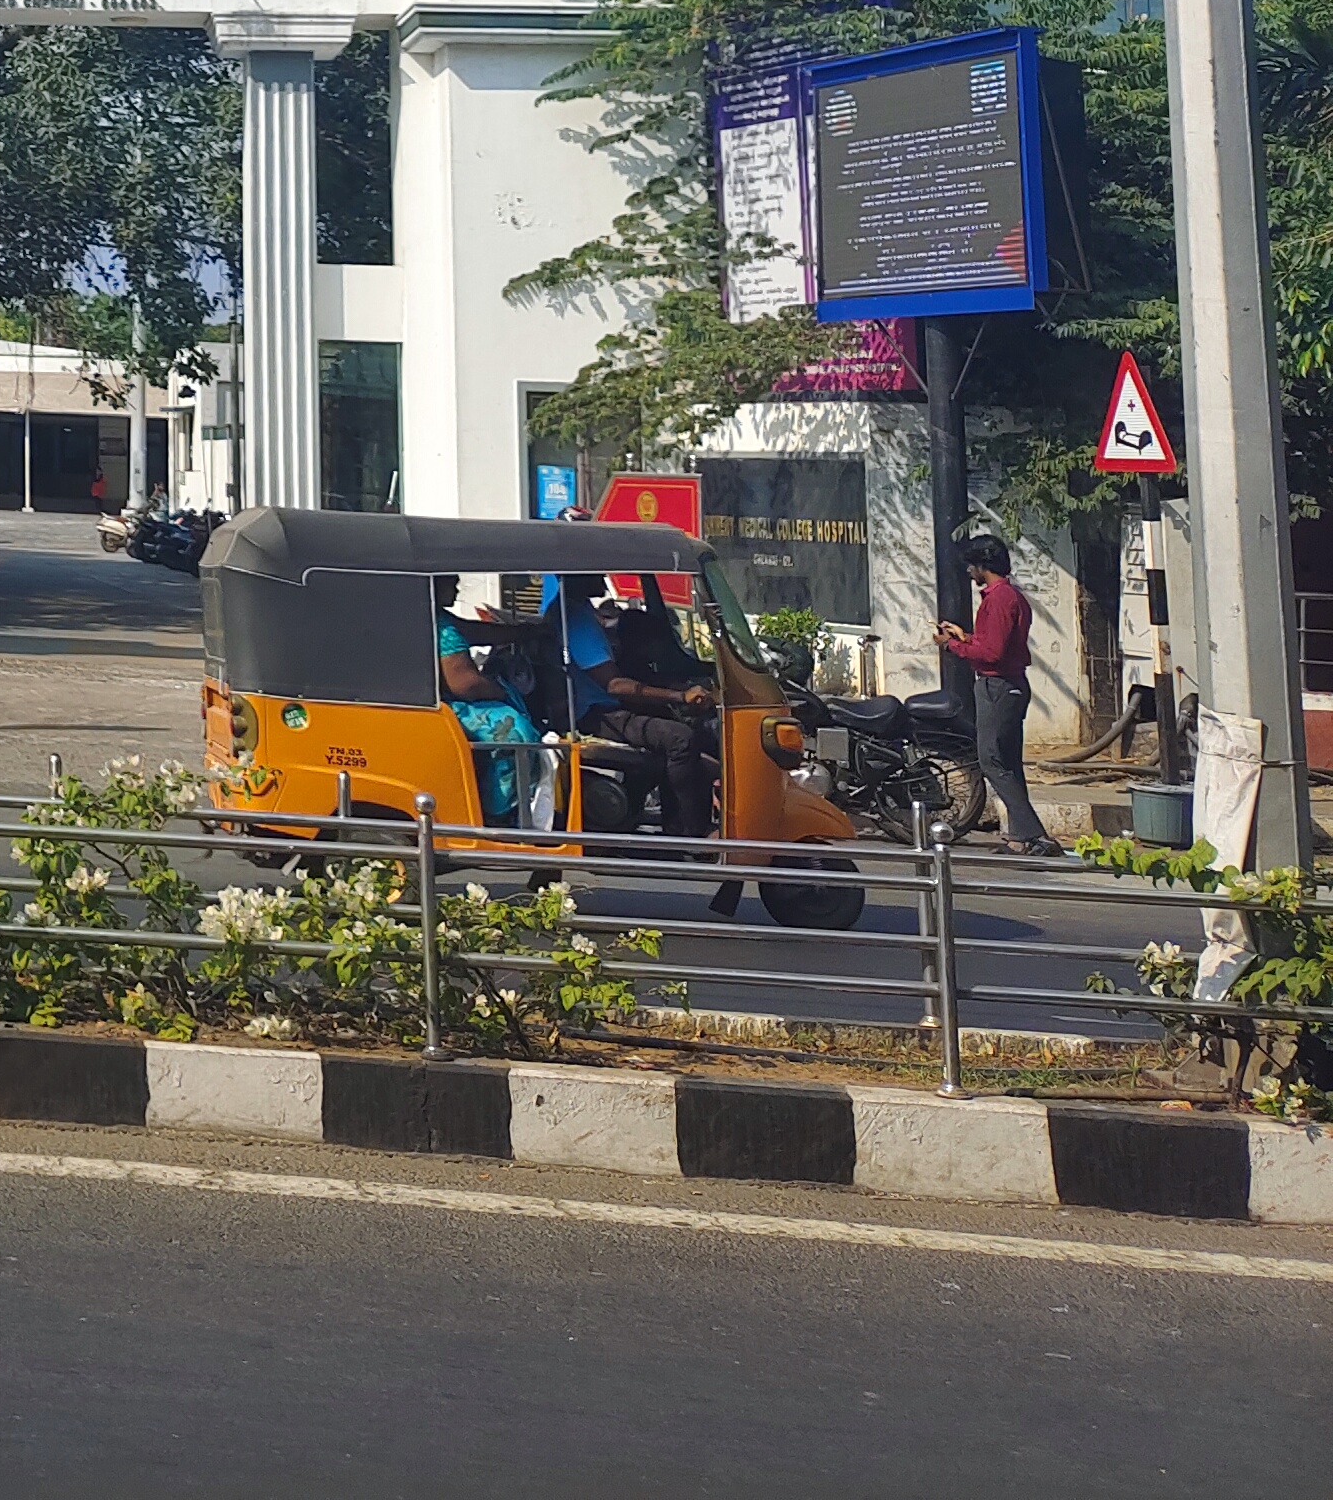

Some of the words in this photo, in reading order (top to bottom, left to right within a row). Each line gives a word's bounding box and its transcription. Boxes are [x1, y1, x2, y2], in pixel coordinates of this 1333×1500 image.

[738, 515, 774, 540] MEDICAL
[776, 517, 814, 542] COLLEGE
[816, 519, 868, 545] HOSPITAL
